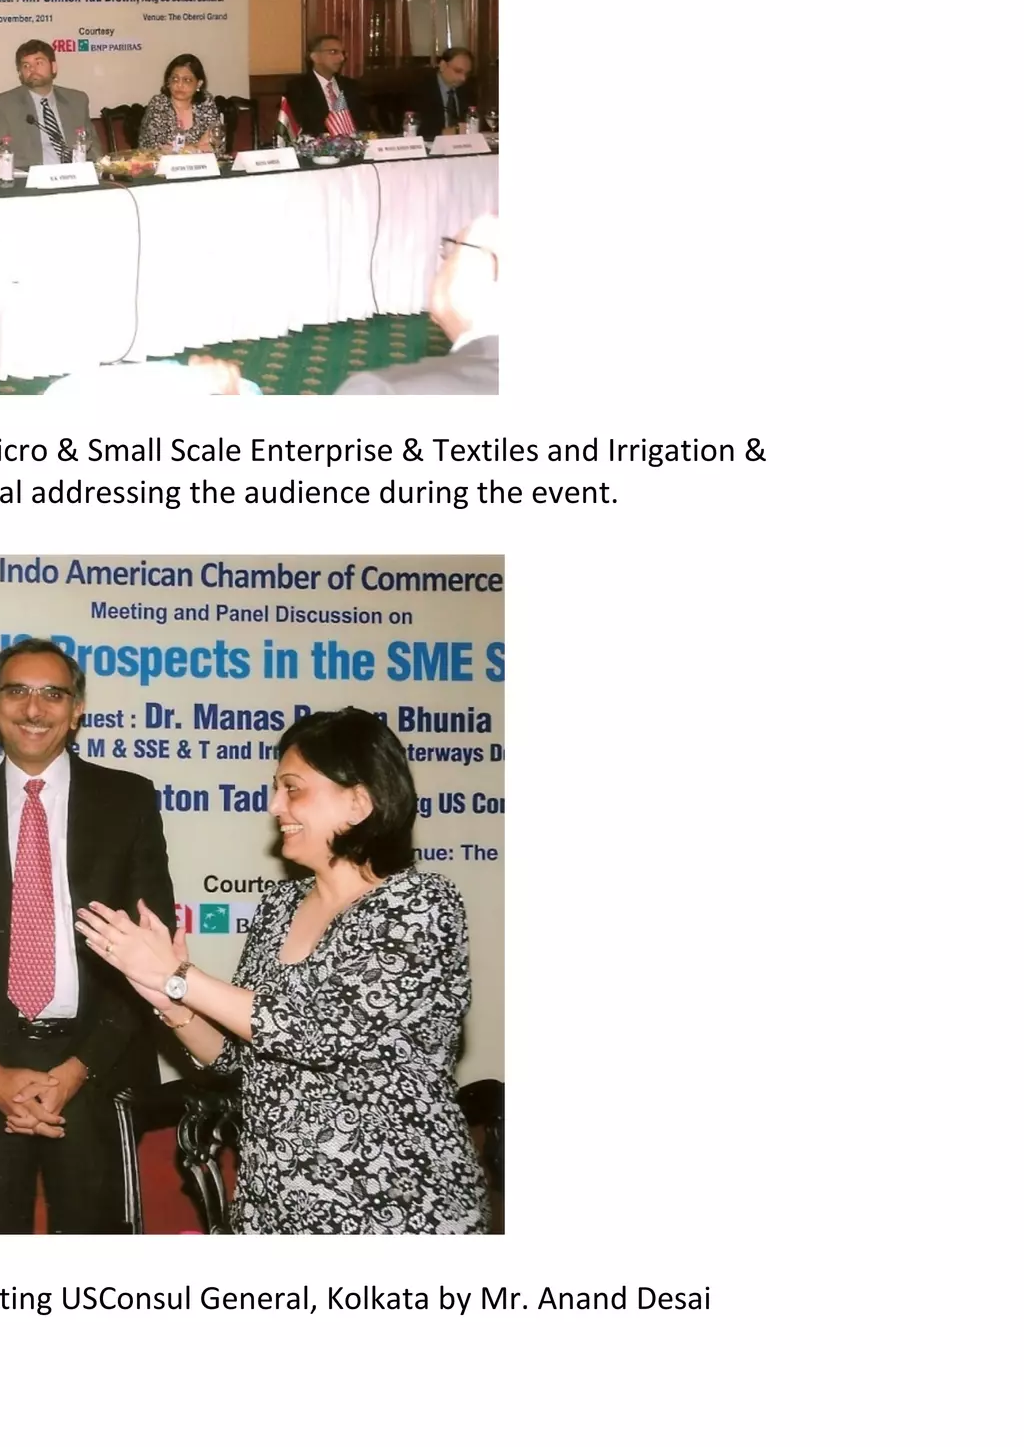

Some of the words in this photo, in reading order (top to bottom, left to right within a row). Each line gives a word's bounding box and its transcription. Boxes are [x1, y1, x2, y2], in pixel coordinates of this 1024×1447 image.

[31, 478, 181, 510] addressing
[189, 478, 236, 504] the
[244, 478, 370, 504] audience
[379, 478, 469, 510] during
[476, 478, 523, 504] the
[532, 482, 618, 504] event.
[0, 557, 59, 584] Indo
[65, 559, 193, 586] American
[200, 562, 320, 590] Chamber
[327, 564, 355, 590] of
[362, 566, 503, 592] Commerce
[91, 601, 167, 624] Meeting
[174, 604, 209, 621] and
[216, 604, 268, 622] Panel
[276, 606, 382, 624] Discussion
[389, 611, 412, 624] on
[264, 639, 298, 680] in
[311, 641, 375, 681] the
[387, 641, 474, 682] SME
[81, 710, 124, 728] uest
[145, 702, 181, 729] Dr.
[194, 703, 285, 731] Manas
[398, 706, 492, 733] Bhunia
[134, 739, 170, 758] SSE
[408, 744, 484, 766] terways
[219, 784, 268, 812] Tad
[439, 792, 466, 814] US
[461, 844, 498, 861] The
[204, 874, 287, 893] Courte
[62, 1285, 191, 1310] USConsul
[200, 1285, 317, 1315] General,
[328, 1285, 429, 1310] Kolkata
[439, 1285, 472, 1316] by
[481, 1286, 528, 1310] Mr.
[537, 1285, 627, 1310] Anand
[638, 1286, 710, 1310] Desai
